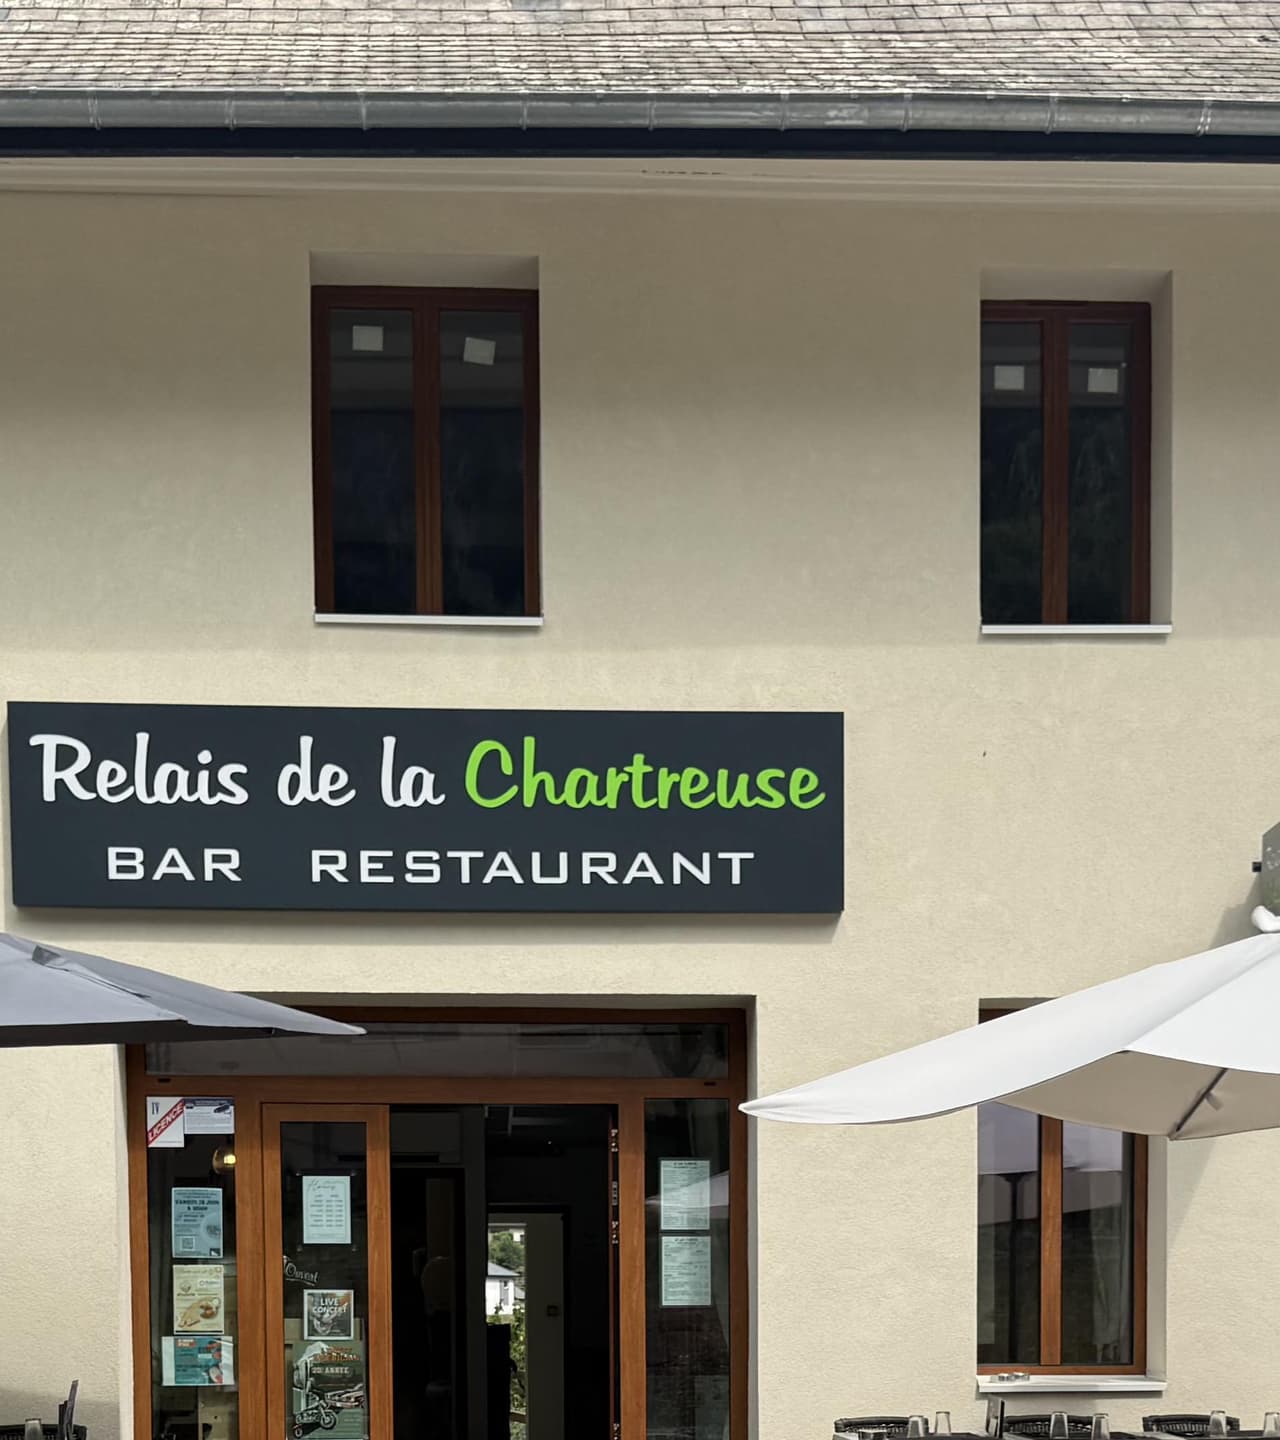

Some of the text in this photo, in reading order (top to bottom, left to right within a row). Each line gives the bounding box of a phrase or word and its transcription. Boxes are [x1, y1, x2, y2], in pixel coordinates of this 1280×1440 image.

[29, 732, 825, 809] Relais de la Chartreuse
[107, 846, 755, 884] BAR RESTAURANT
[148, 1102, 184, 1140] LICENCE
[321, 1298, 338, 1306] LIVE
